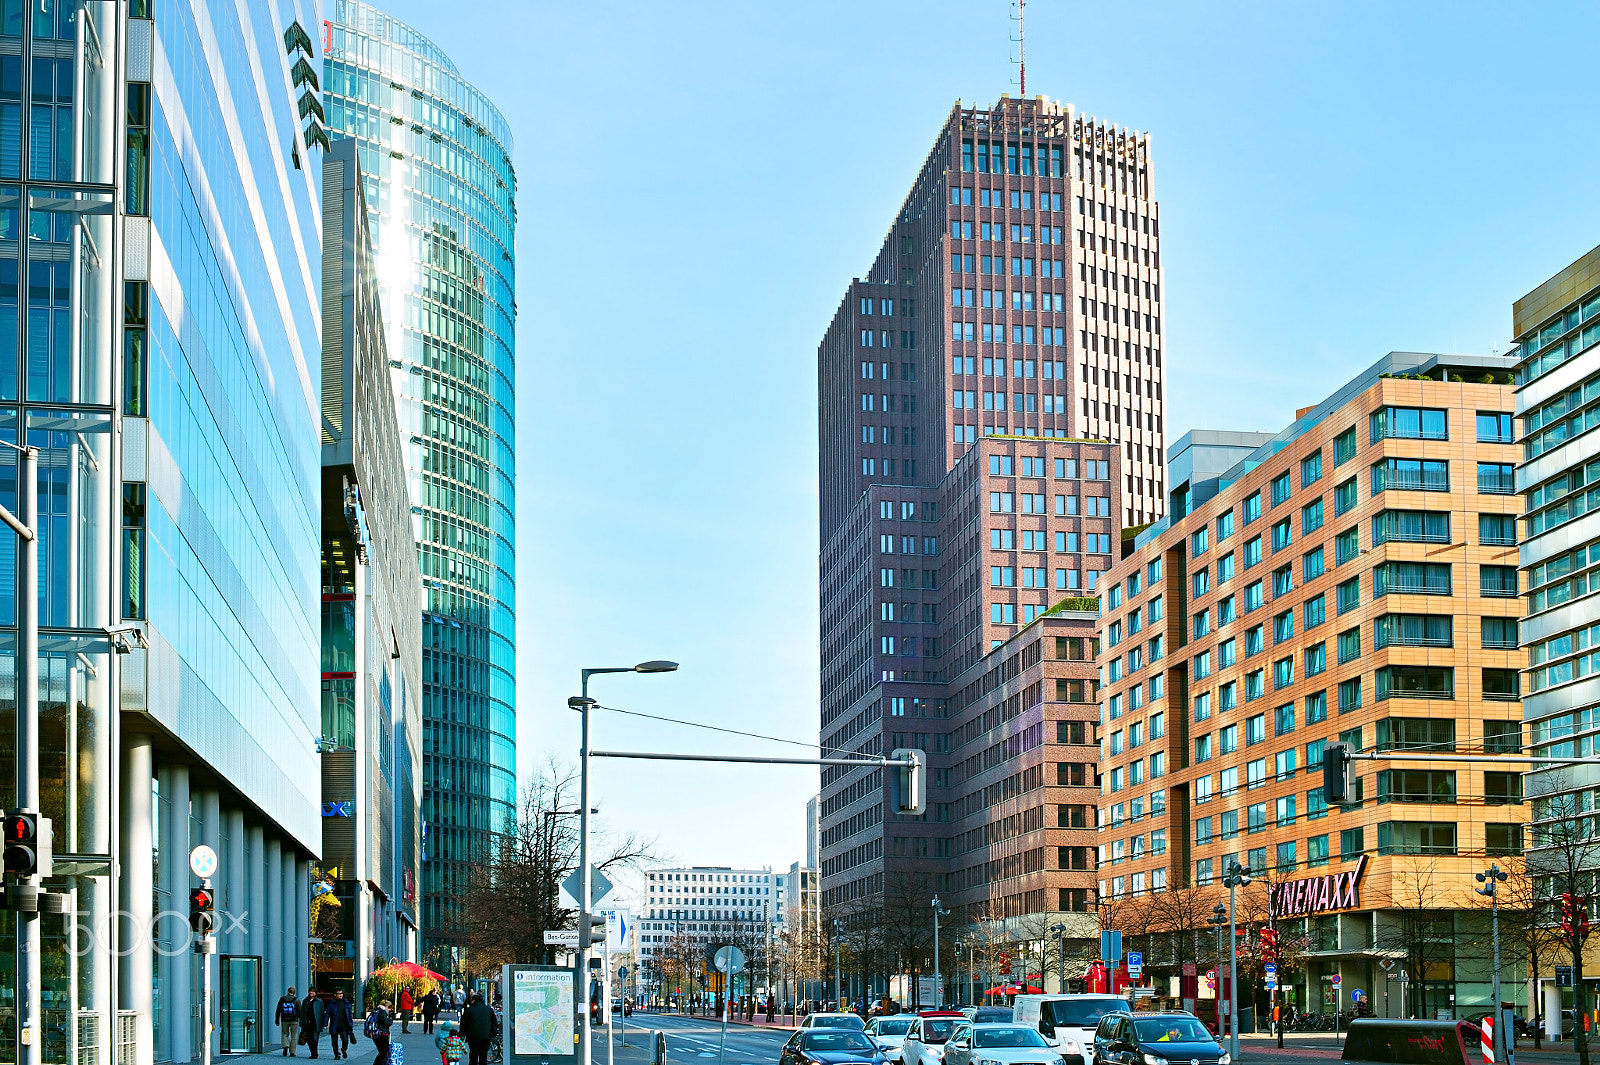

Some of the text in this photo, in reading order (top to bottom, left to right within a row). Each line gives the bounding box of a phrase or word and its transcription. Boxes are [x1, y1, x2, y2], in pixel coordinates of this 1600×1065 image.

[1268, 855, 1365, 917] CINEMAXX
[1132, 956, 1139, 964] P
[526, 973, 571, 981] information
